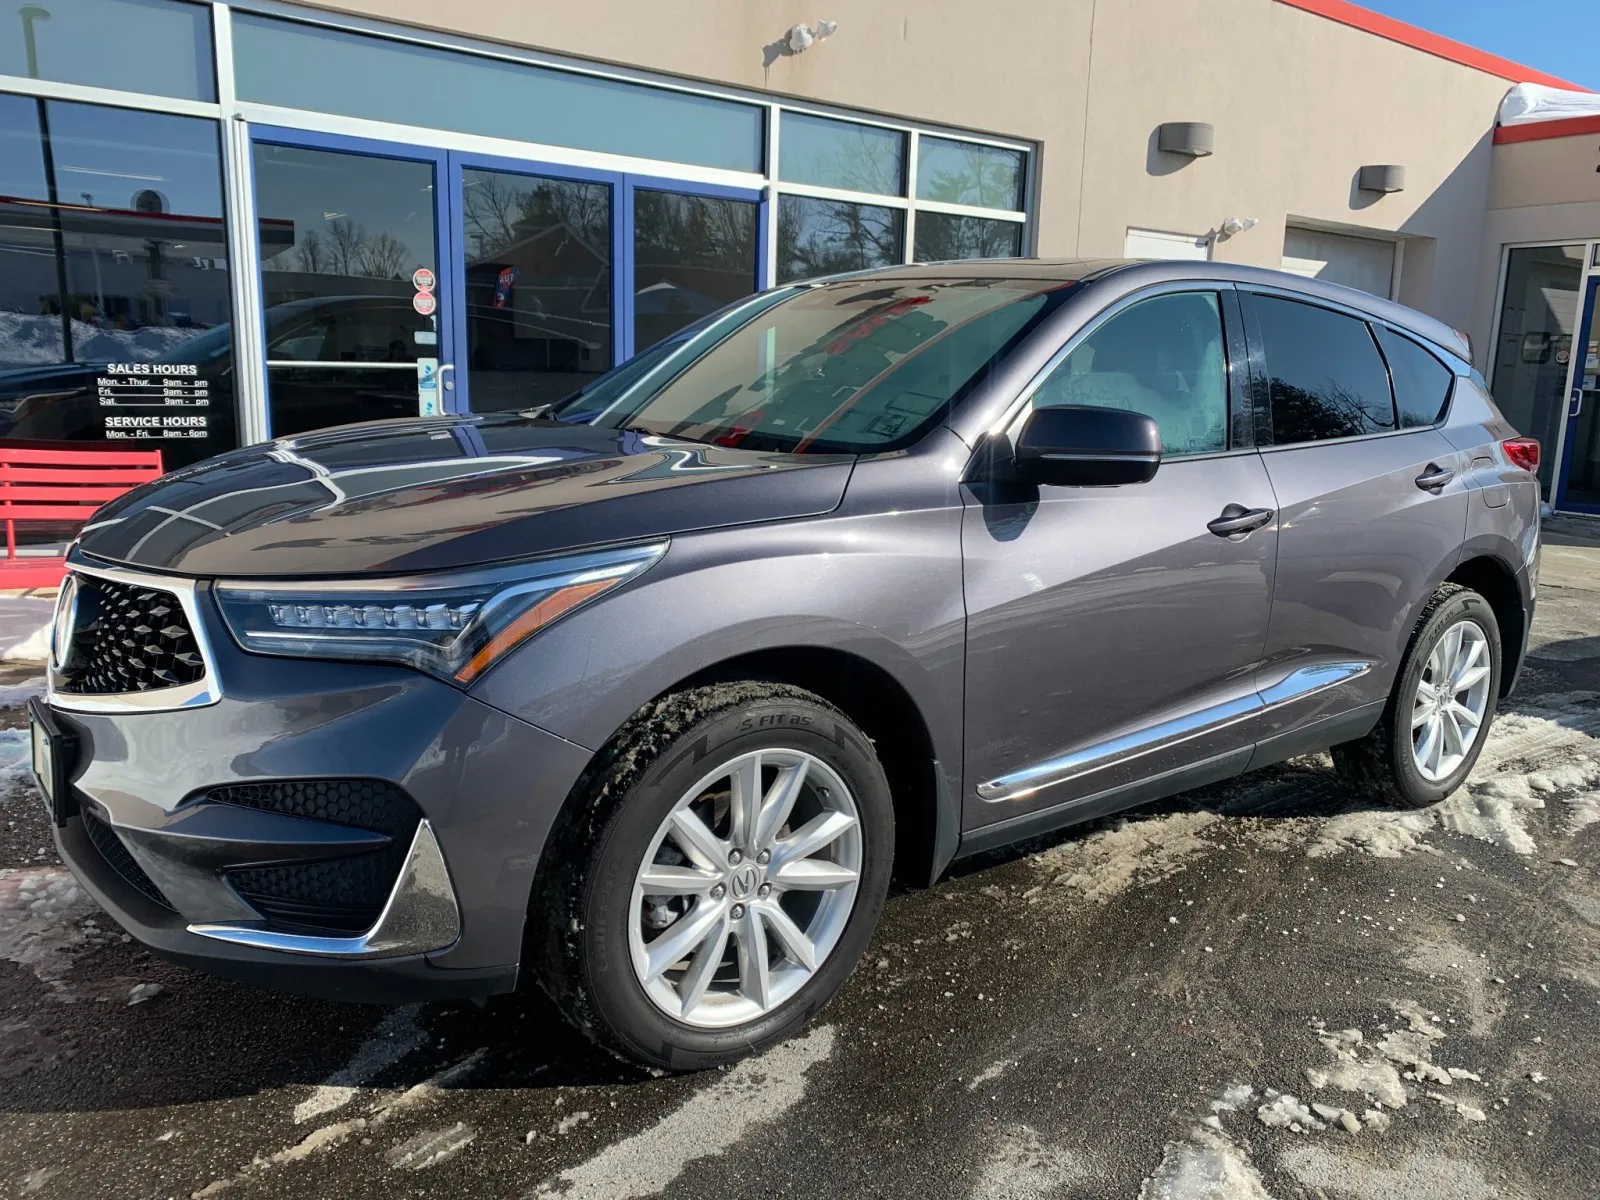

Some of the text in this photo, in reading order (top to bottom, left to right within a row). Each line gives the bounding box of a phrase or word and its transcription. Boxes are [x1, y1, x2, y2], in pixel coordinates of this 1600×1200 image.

[107, 364, 197, 374] SALES HOURS
[97, 378, 120, 386] Mon.
[128, 378, 150, 386] Thur.
[163, 378, 182, 386] 9am
[98, 387, 113, 395] Fri.
[163, 388, 182, 396] 9am
[194, 389, 208, 397] pm
[99, 397, 117, 405] Sat.
[195, 398, 209, 406] pm
[105, 416, 207, 426] SERVICE HOURS
[105, 430, 128, 438] Mon.
[189, 430, 208, 438] 6pm
[740, 719, 753, 732] S
[760, 714, 786, 726] FIT
